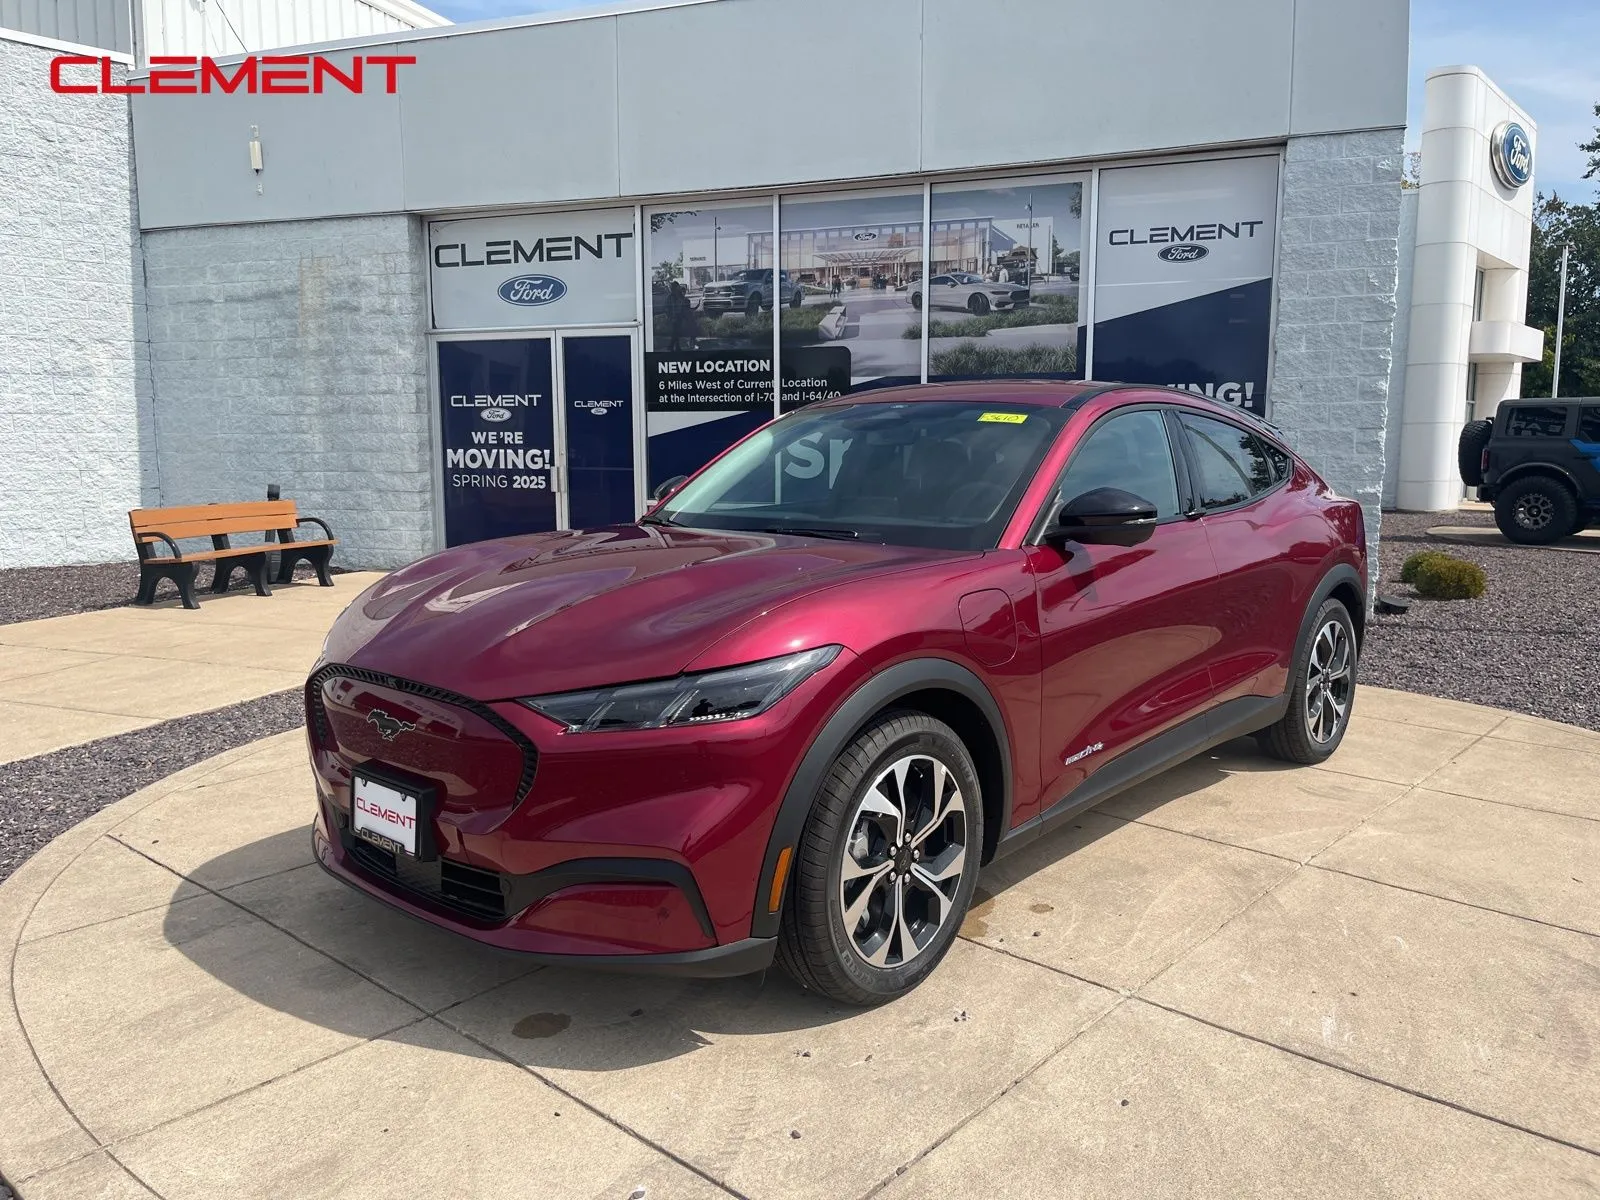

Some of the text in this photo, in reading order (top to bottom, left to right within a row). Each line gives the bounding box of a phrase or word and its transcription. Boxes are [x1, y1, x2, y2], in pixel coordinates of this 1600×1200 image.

[1109, 220, 1263, 246] CLEMENT
[434, 232, 633, 268] CLEMENT
[1166, 245, 1200, 261] Ford
[508, 277, 555, 302] Ford
[658, 359, 770, 374] NEW LOCATION
[659, 377, 828, 390] 6 Miles West of Current Location
[450, 394, 541, 407] CLEMENT
[574, 400, 624, 408] CLEMENT
[659, 394, 668, 403] at
[670, 393, 685, 403] the
[687, 392, 742, 403] Intersection
[744, 392, 755, 402] of
[781, 390, 800, 401] and
[485, 407, 508, 421] Ford
[471, 431, 524, 444] WE'RE
[446, 448, 550, 470] MOVING!
[452, 474, 546, 489] SPRING 2025
[356, 797, 417, 830] CLEMENT
[361, 829, 402, 854] CLEMENT
